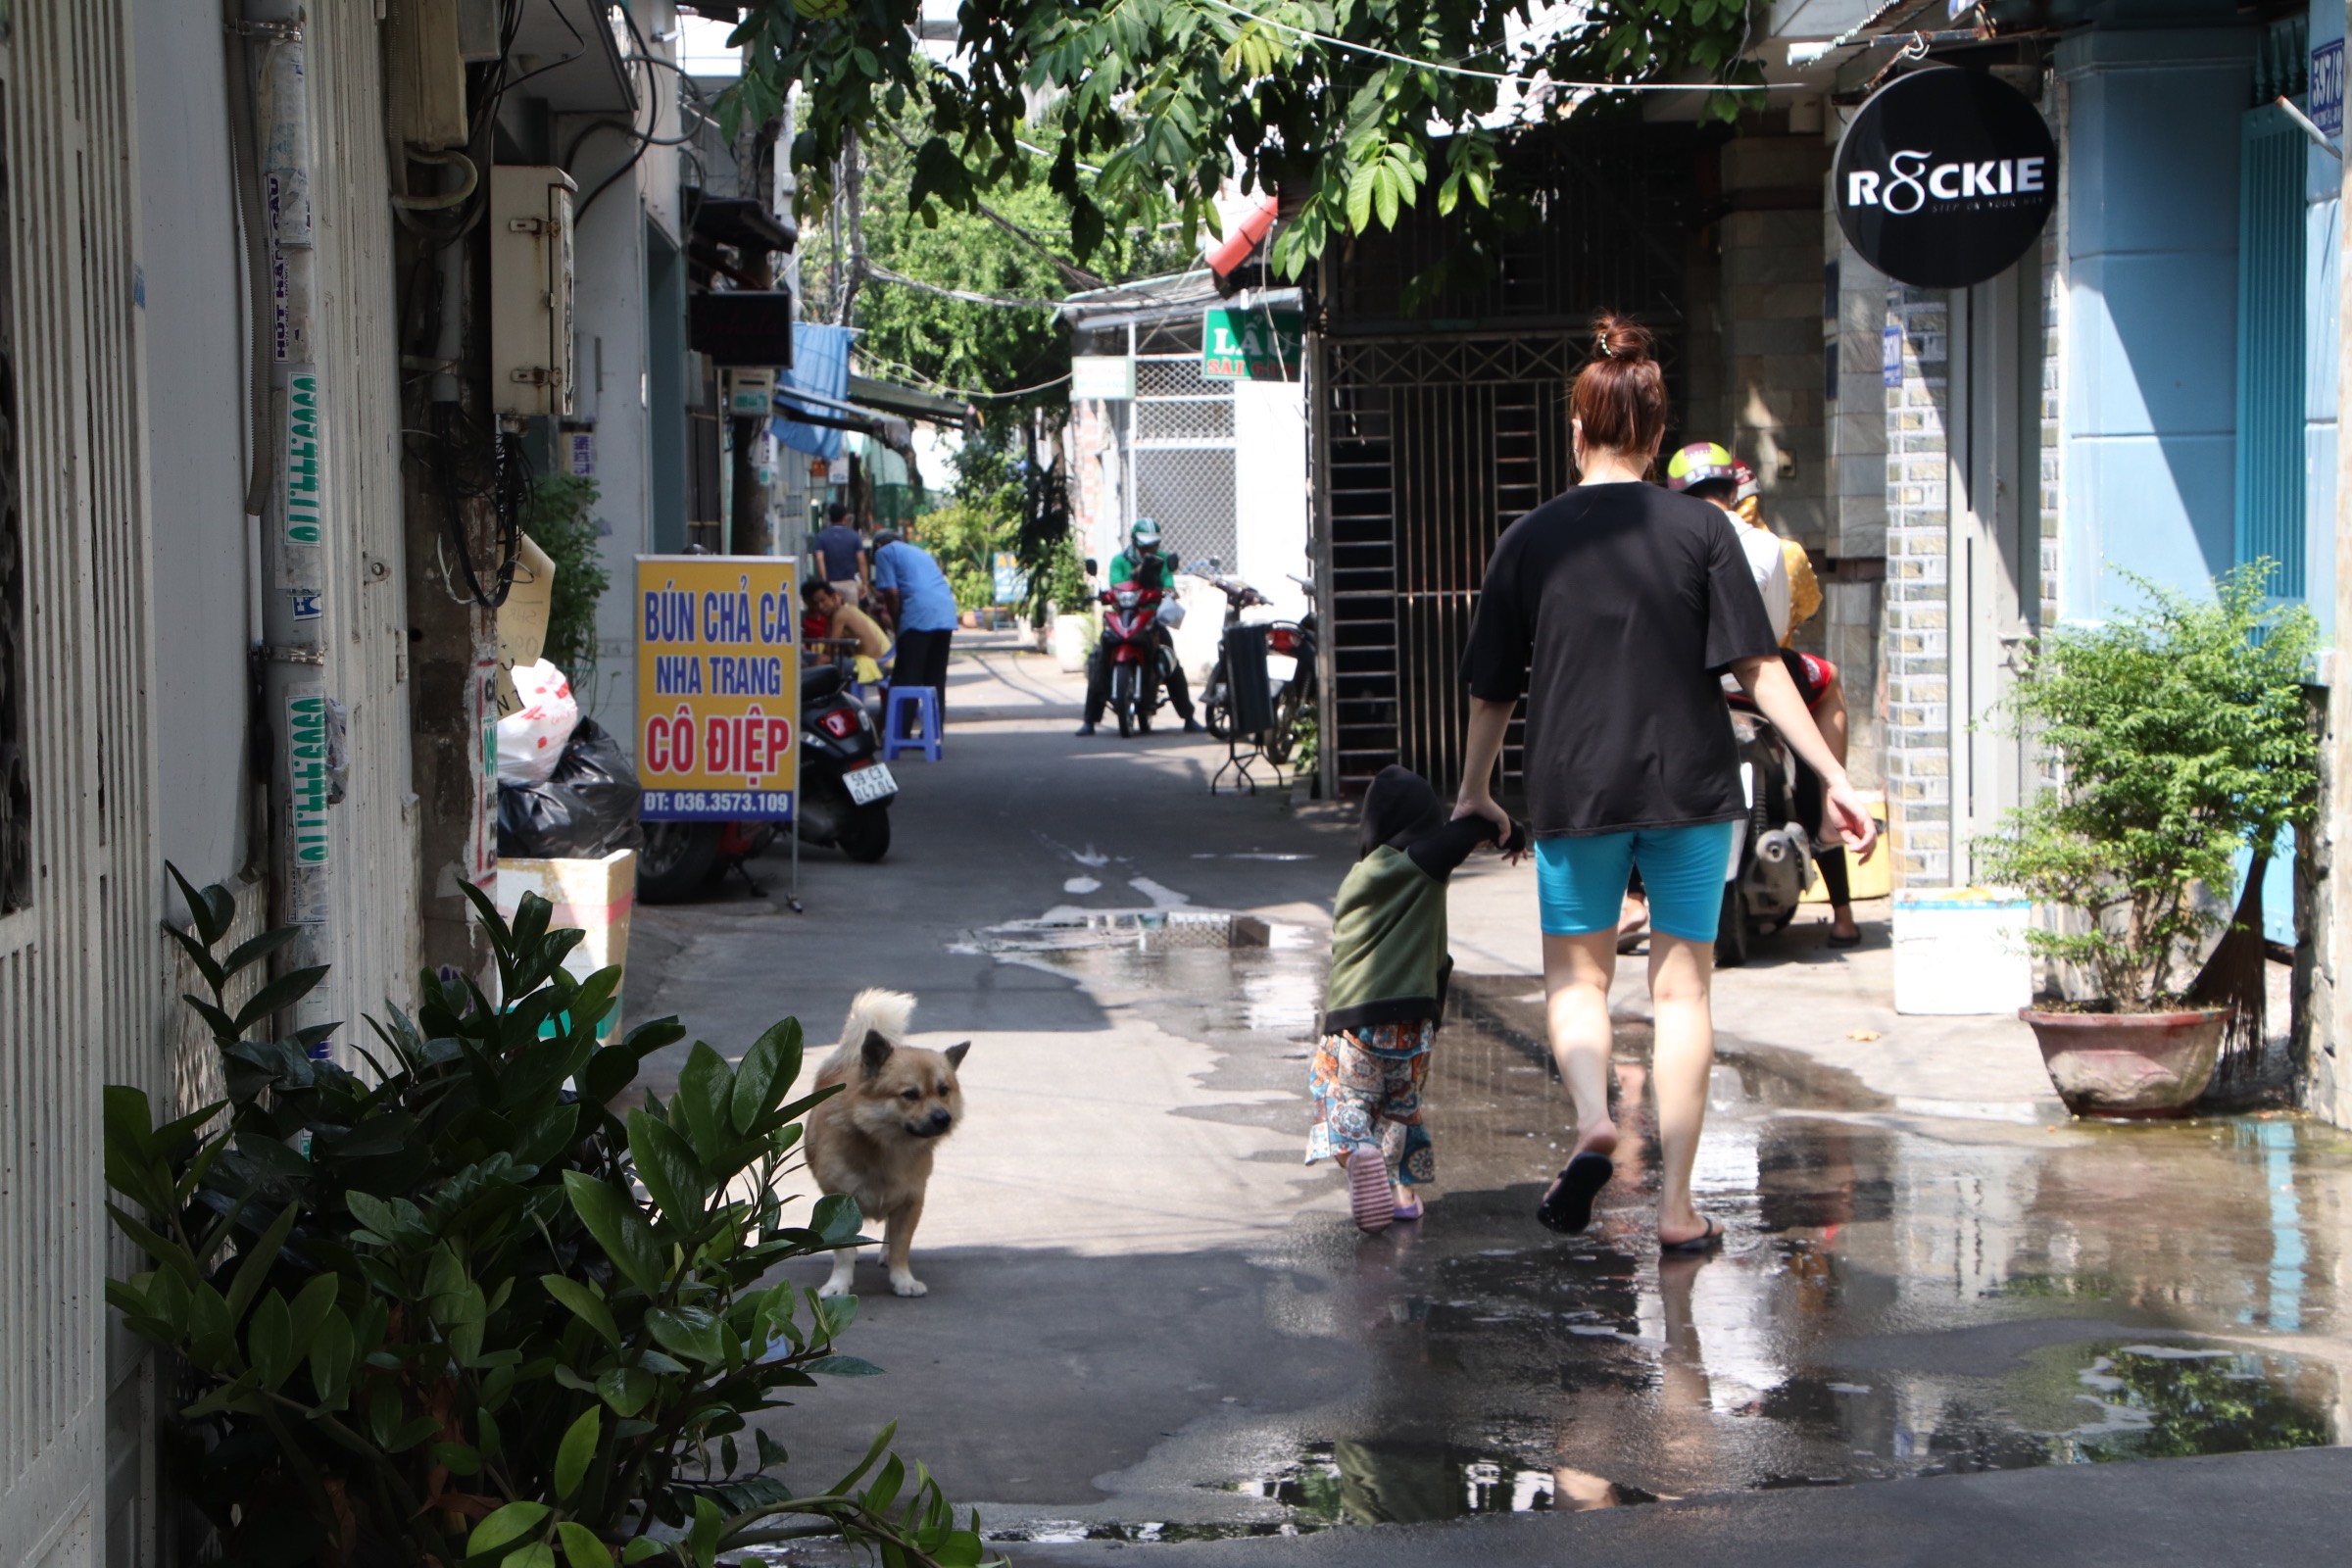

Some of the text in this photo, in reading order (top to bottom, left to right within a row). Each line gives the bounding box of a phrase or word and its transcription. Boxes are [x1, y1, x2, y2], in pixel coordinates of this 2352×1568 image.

[2313, 50, 2342, 108] 597/8
[274, 304, 286, 358] HÚT
[1212, 314, 1294, 357] LẨU
[644, 575, 792, 644] BÚN CHẢ CÁ
[656, 656, 781, 696] NHA TRANG
[646, 705, 790, 786] CÔ ĐIỆP
[851, 765, 883, 787] 59-C3
[644, 792, 789, 812] ĐT: 036.3573.109
